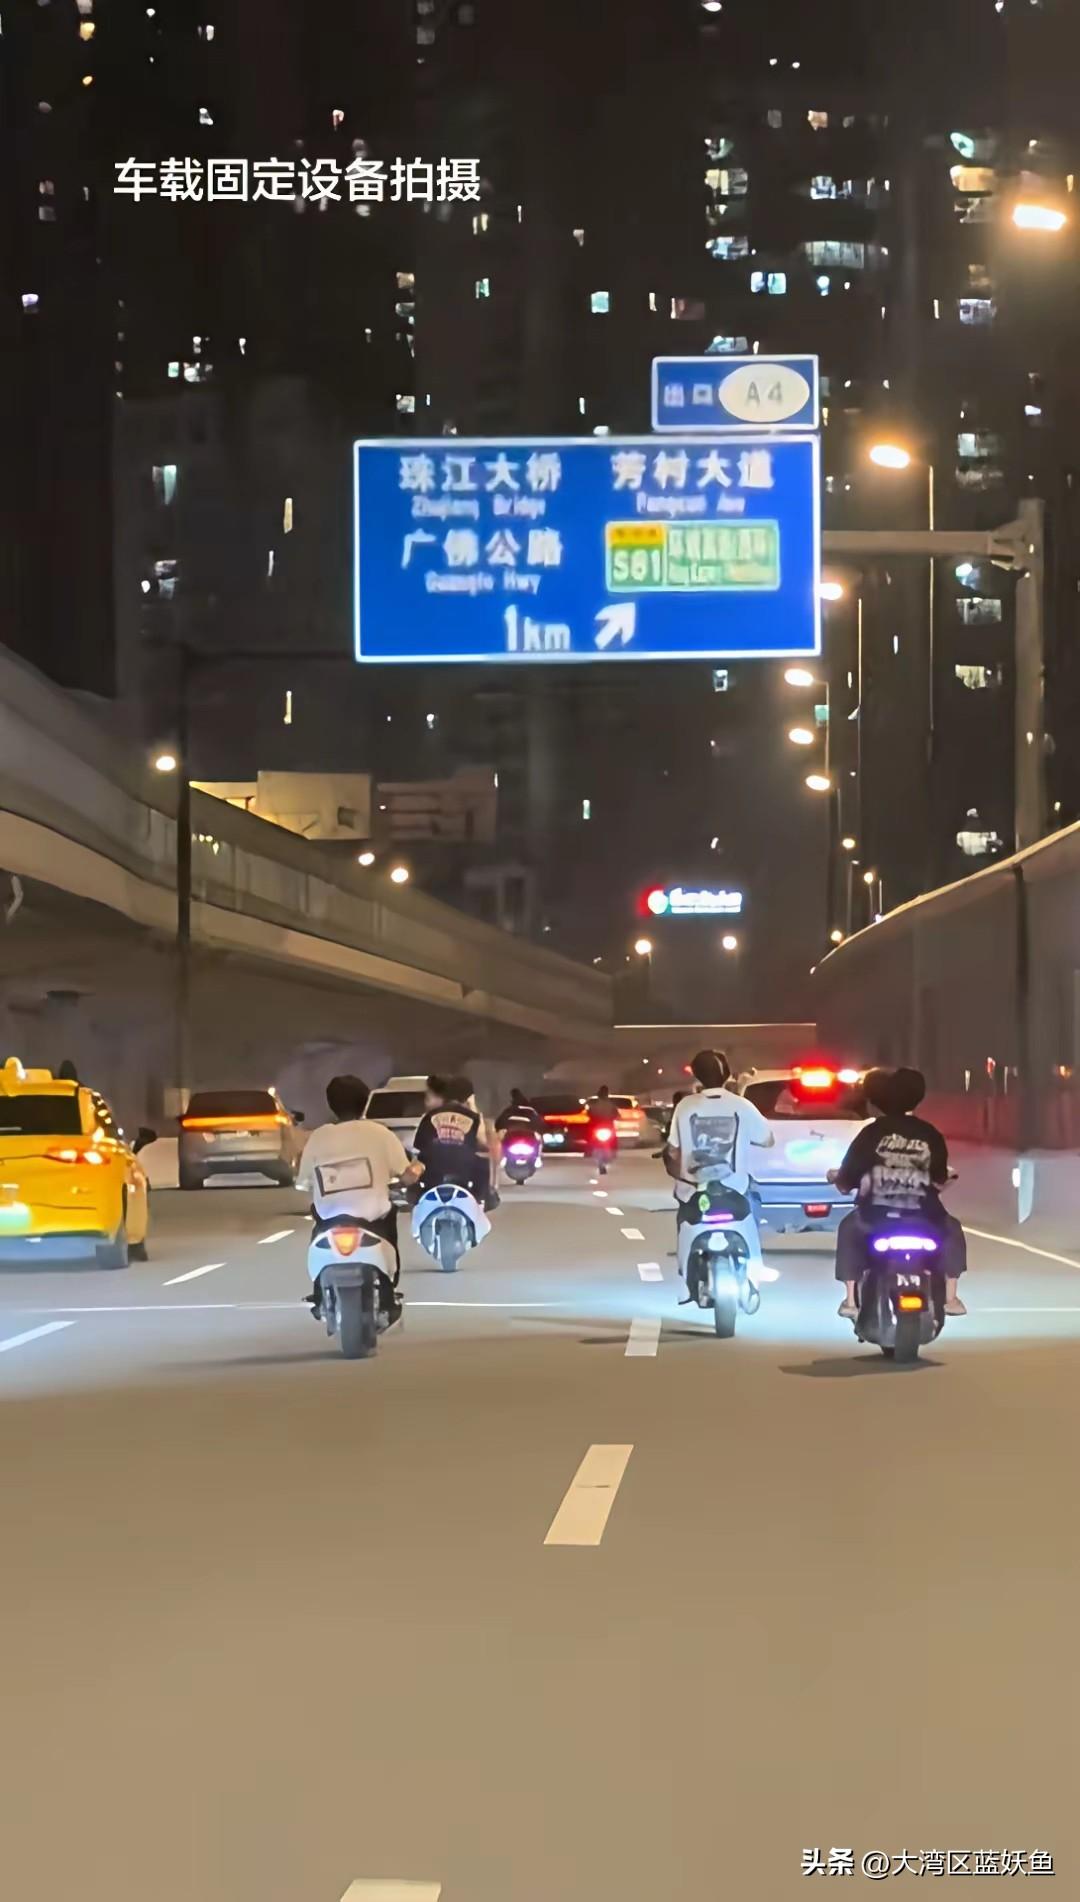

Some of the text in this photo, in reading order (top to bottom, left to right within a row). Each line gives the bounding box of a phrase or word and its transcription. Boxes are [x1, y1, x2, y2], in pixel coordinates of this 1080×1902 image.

[746, 381, 784, 407] A4
[399, 453, 562, 492] 珠江大桥
[611, 450, 774, 490] 芳村大道
[401, 529, 564, 570] 广佛公路
[504, 603, 571, 652] 1km
